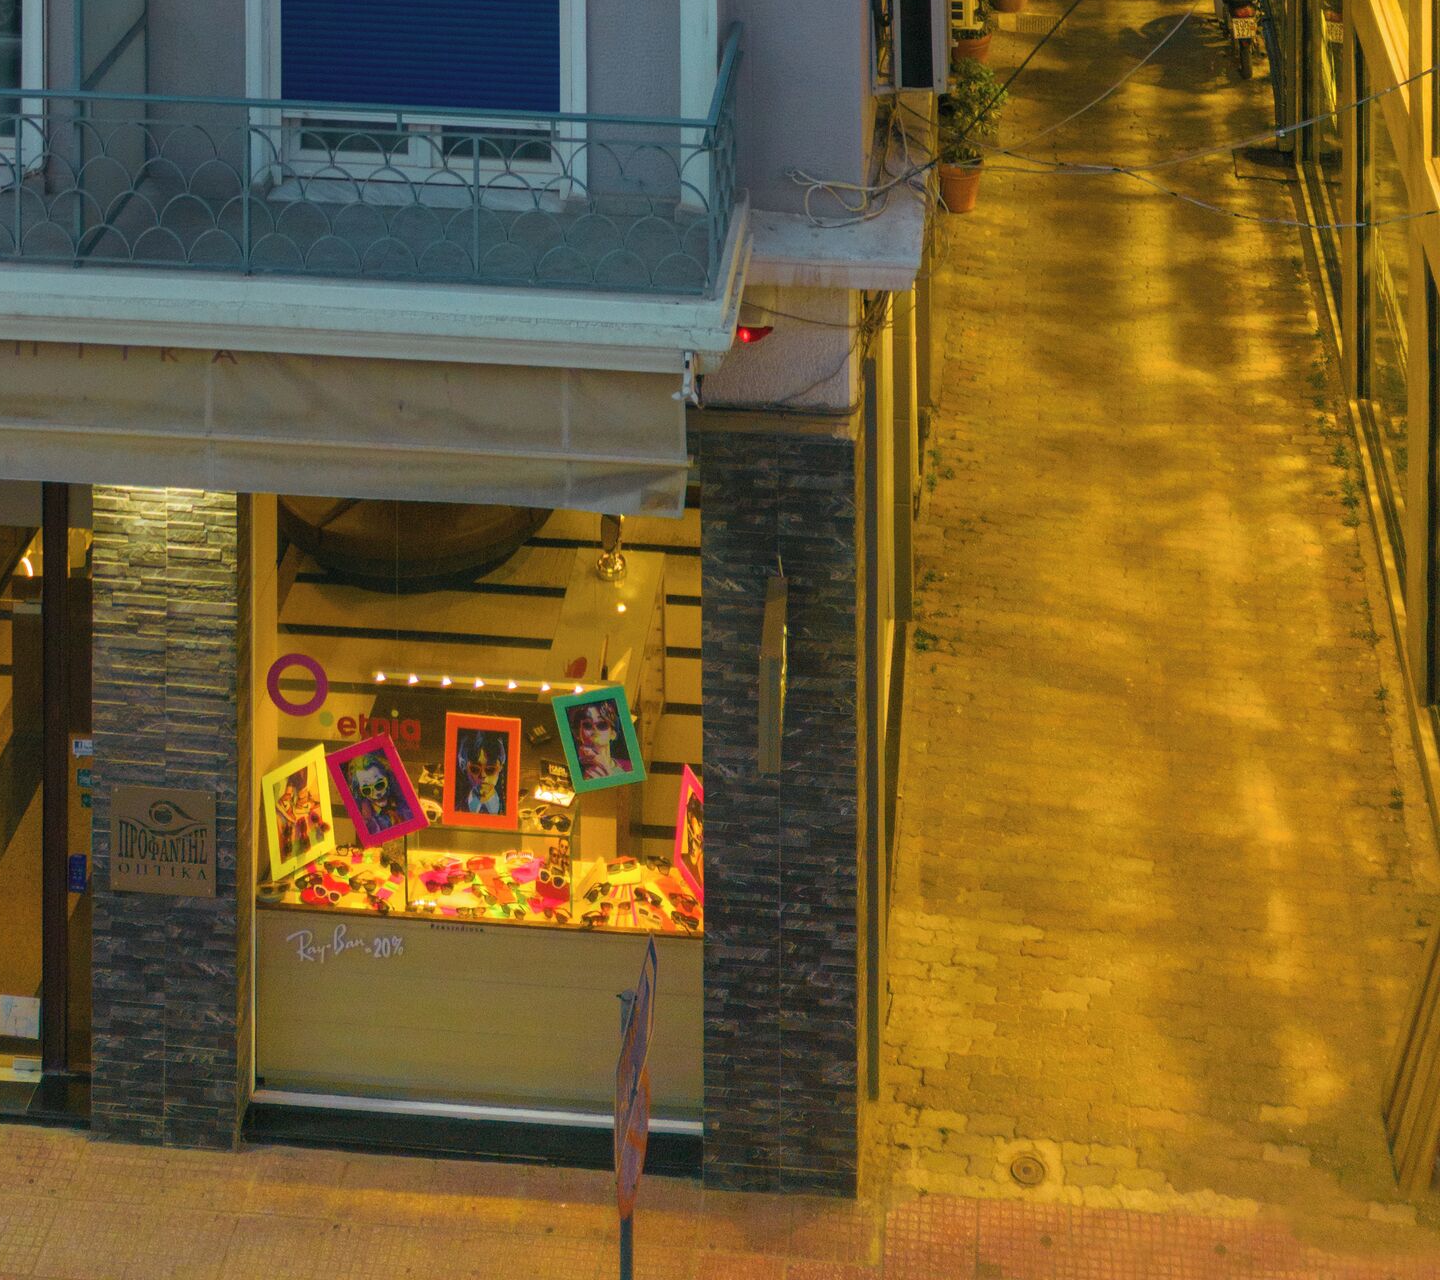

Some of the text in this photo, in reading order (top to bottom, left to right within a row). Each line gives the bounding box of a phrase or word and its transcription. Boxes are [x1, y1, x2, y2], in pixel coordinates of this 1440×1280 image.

[337, 709, 421, 742] etnia
[118, 820, 208, 864] ΠΡΟΦΑΝΤΗΣ
[118, 863, 208, 880] ΟΠΤΙΚΑ
[286, 923, 365, 964] Ray-Ban
